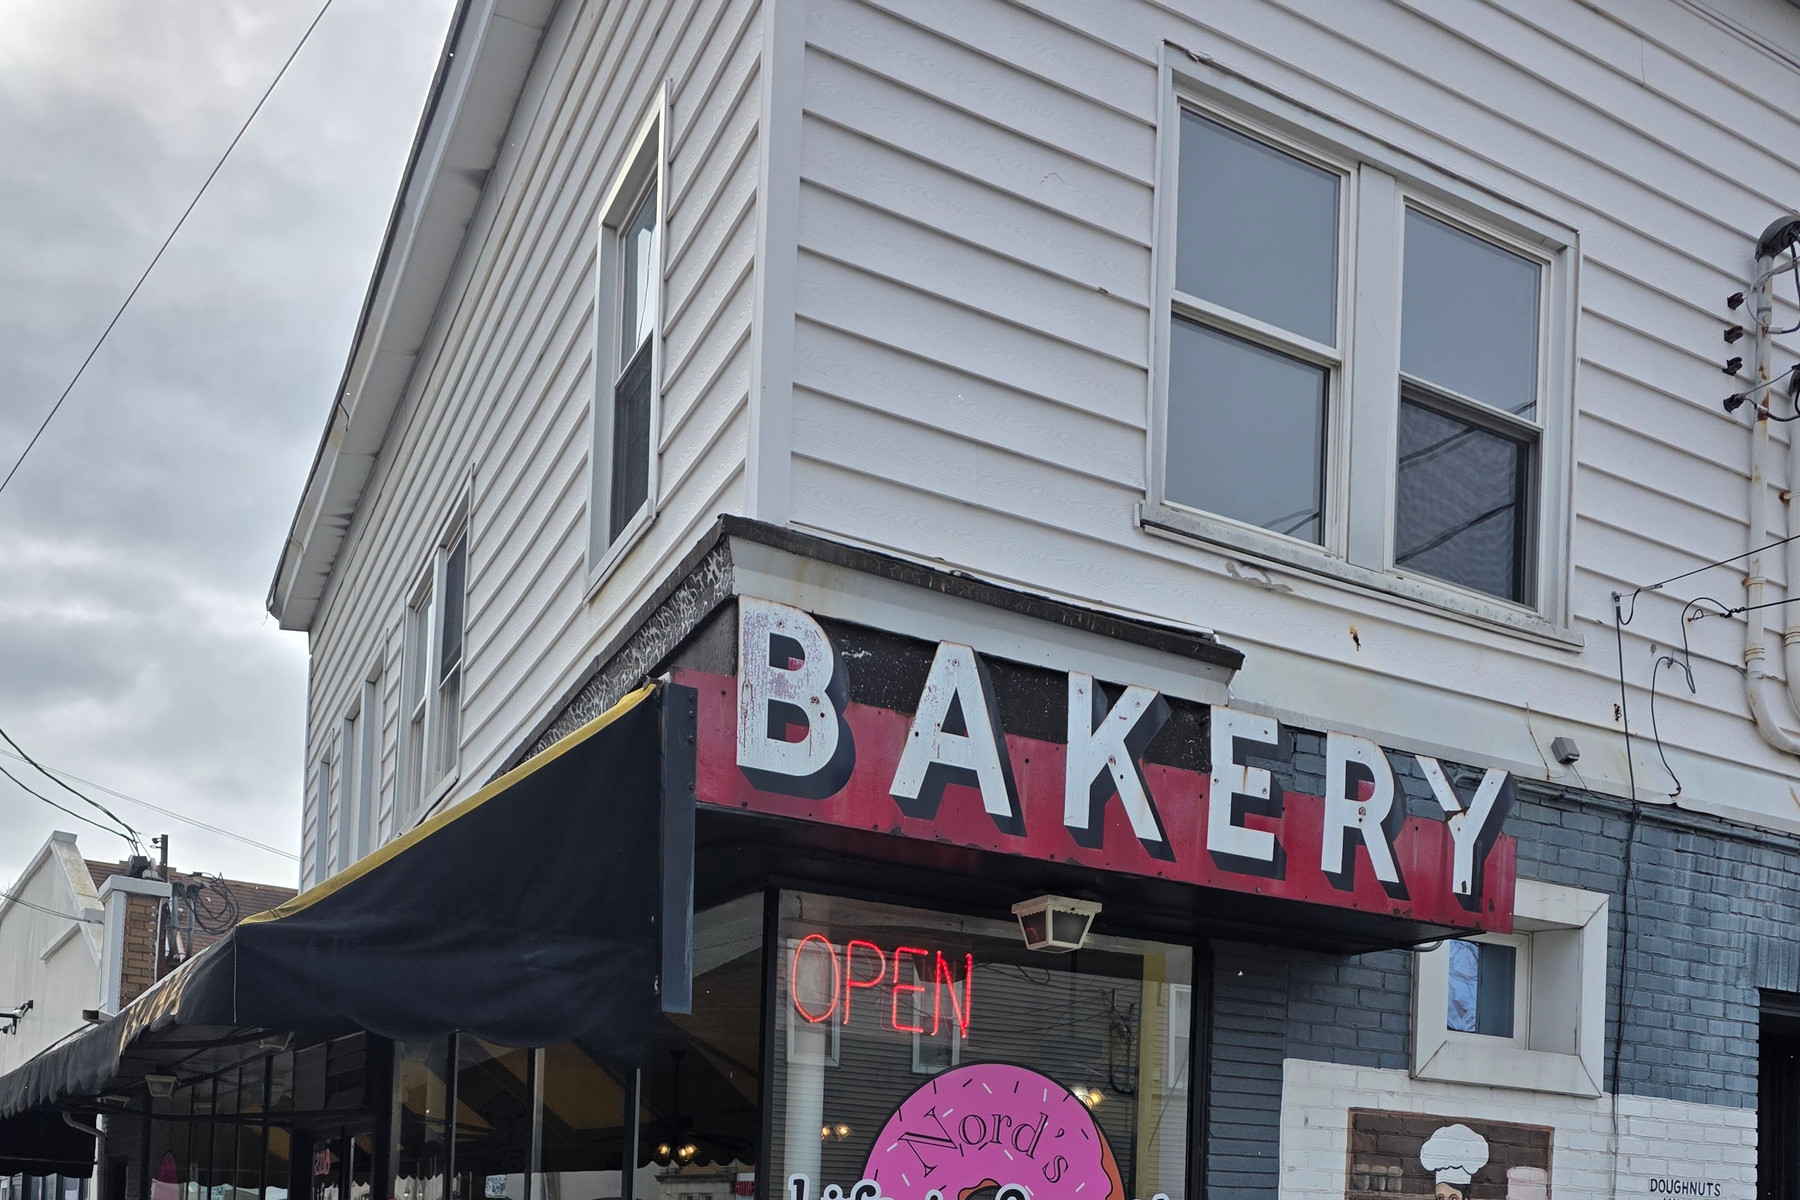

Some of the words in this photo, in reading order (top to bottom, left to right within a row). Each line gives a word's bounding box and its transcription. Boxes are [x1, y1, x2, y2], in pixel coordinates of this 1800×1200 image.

[736, 595, 1514, 906] BAKERY
[790, 933, 974, 1039] OPEN
[897, 1105, 1069, 1184] Nord's
[1650, 1178, 1721, 1197] DOUGHNUTS
